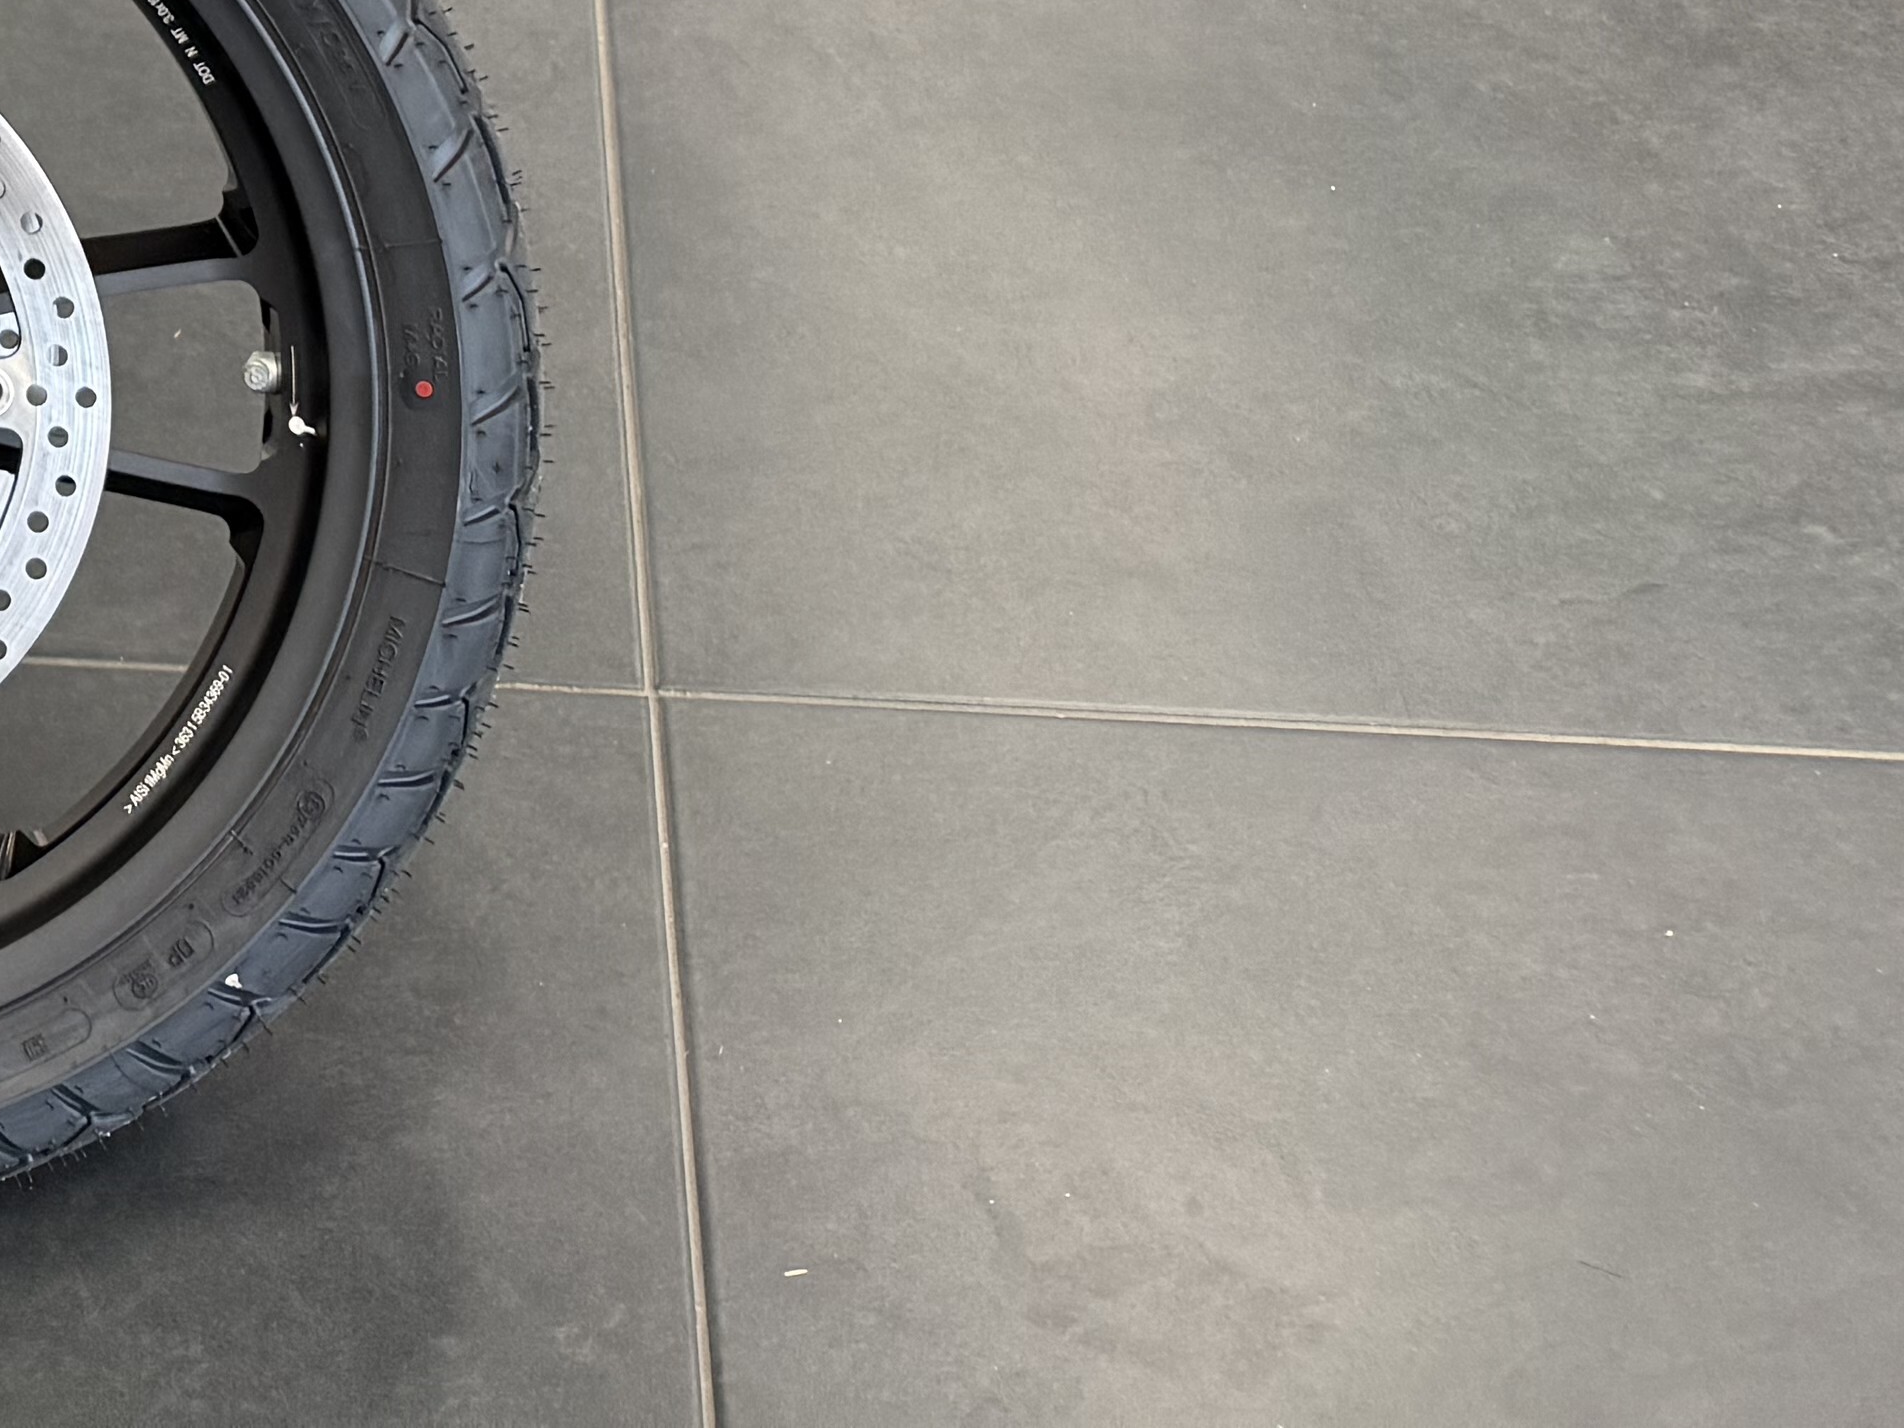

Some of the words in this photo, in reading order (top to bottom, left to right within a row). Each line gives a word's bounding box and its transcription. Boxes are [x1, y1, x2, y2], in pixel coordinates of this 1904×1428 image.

[170, 27, 189, 44] MT
[184, 46, 198, 58] N
[192, 62, 215, 85] DOT
